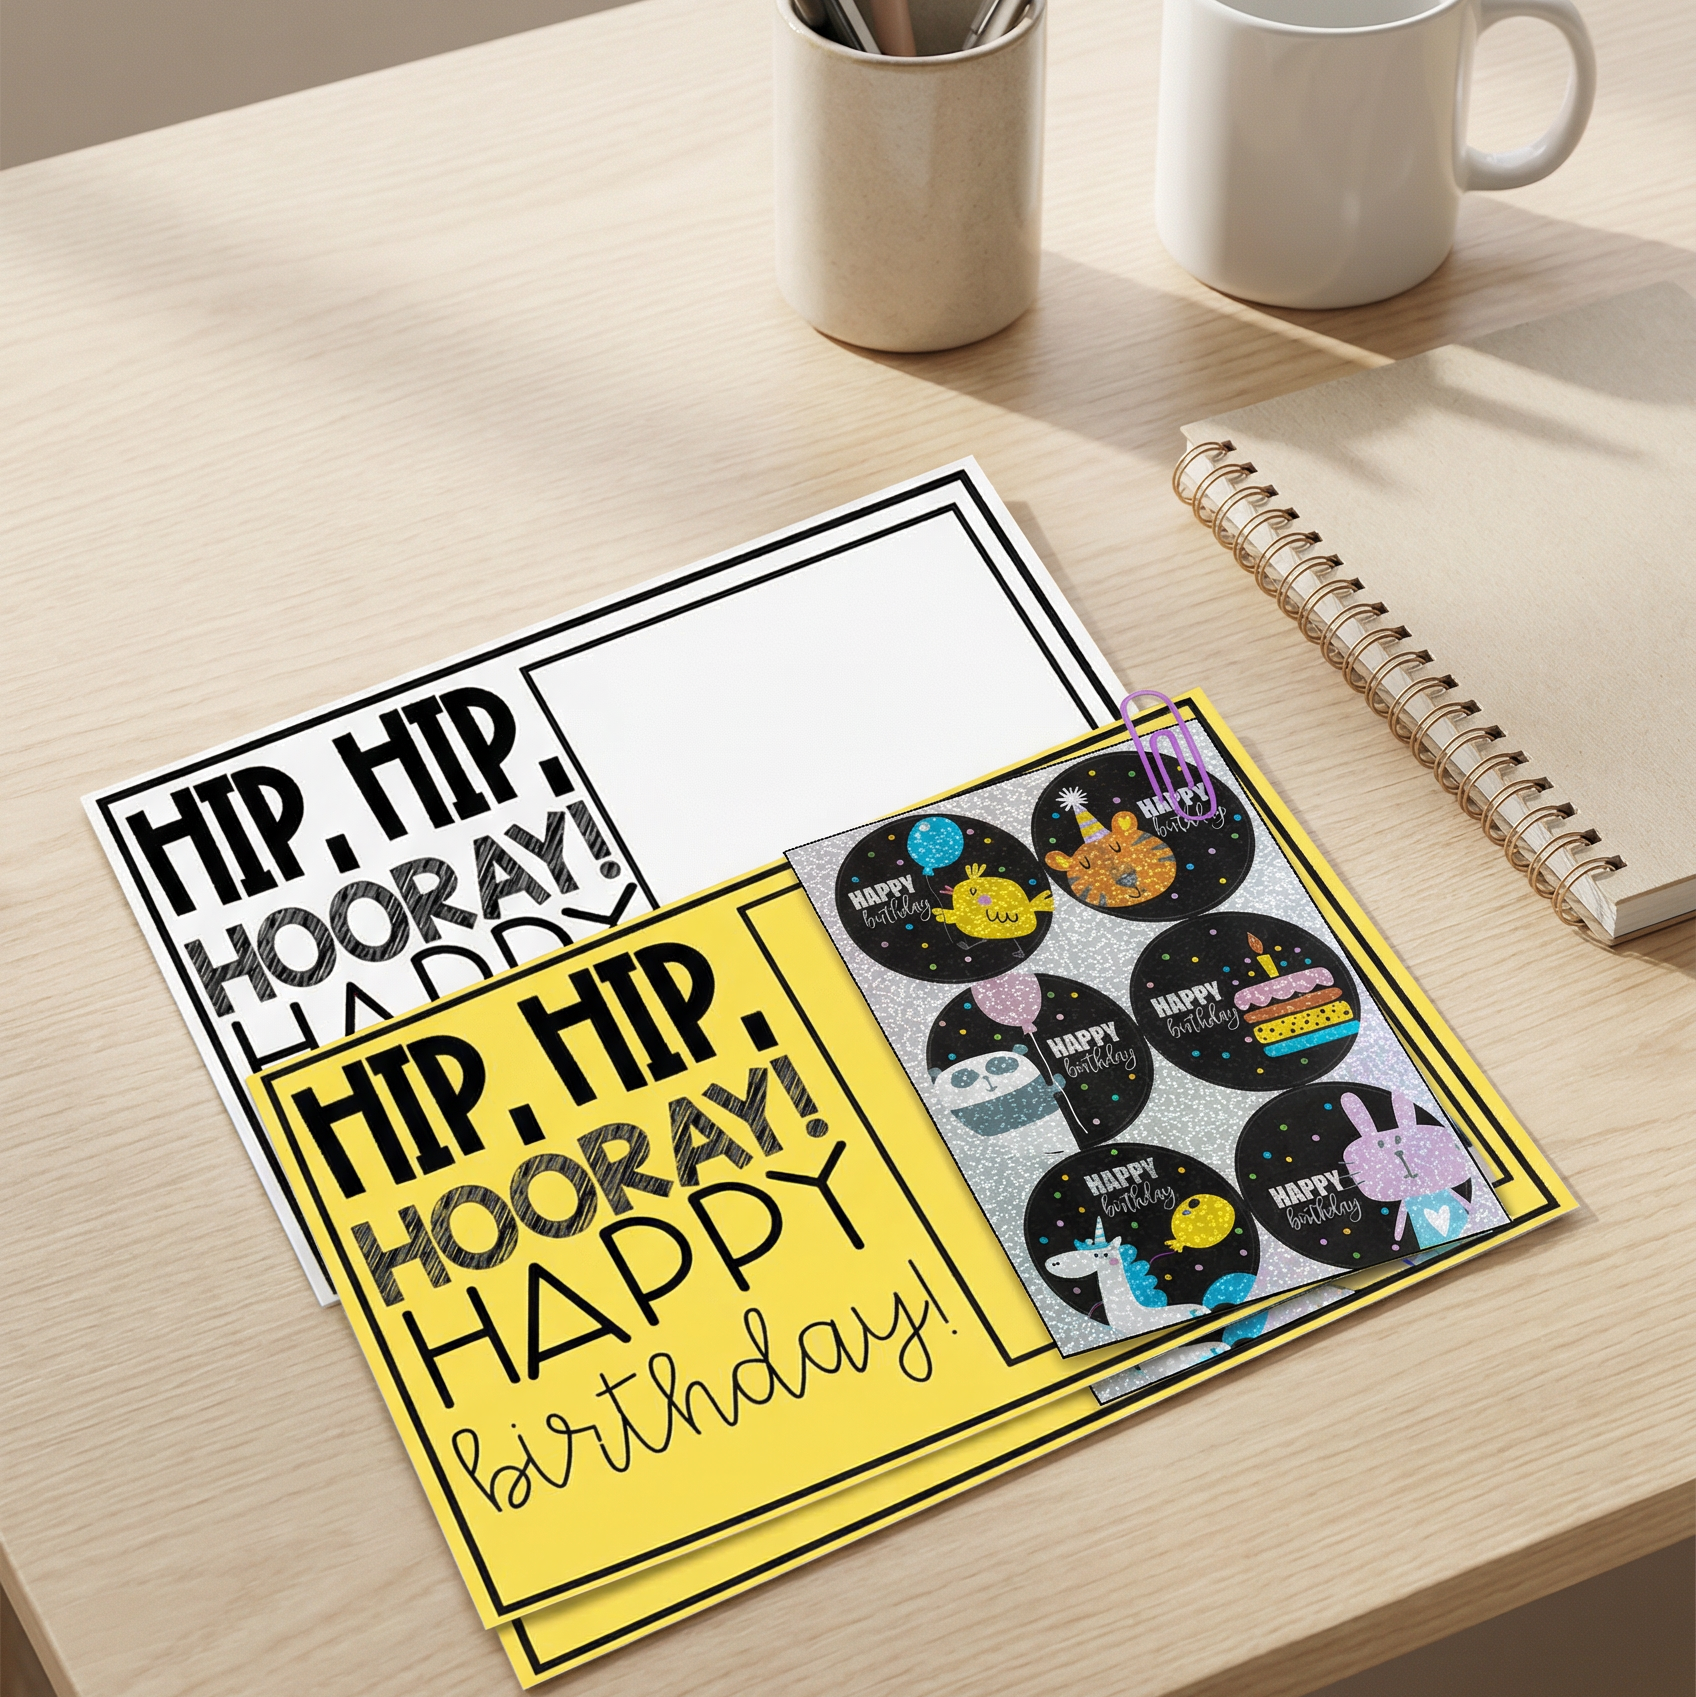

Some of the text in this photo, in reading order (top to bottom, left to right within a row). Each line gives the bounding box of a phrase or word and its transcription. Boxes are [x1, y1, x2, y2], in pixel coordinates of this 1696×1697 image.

[183, 799, 620, 1018] HOORAY!
[847, 874, 915, 911] HAPPY
[862, 895, 931, 929] birthday
[1150, 980, 1221, 1018] HAPPY
[1167, 1003, 1239, 1038] birthday
[1046, 1021, 1120, 1059] HAPPY
[1064, 1043, 1136, 1077] birthday
[351, 1054, 829, 1307] HOORAY!
[1083, 1157, 1158, 1196] HAPPY
[1268, 1169, 1344, 1209] HAPPY
[1101, 1181, 1175, 1217] birthday
[1286, 1193, 1361, 1230] birthday
[402, 1140, 865, 1409] HAPPY
[451, 1259, 958, 1513] birthday!
